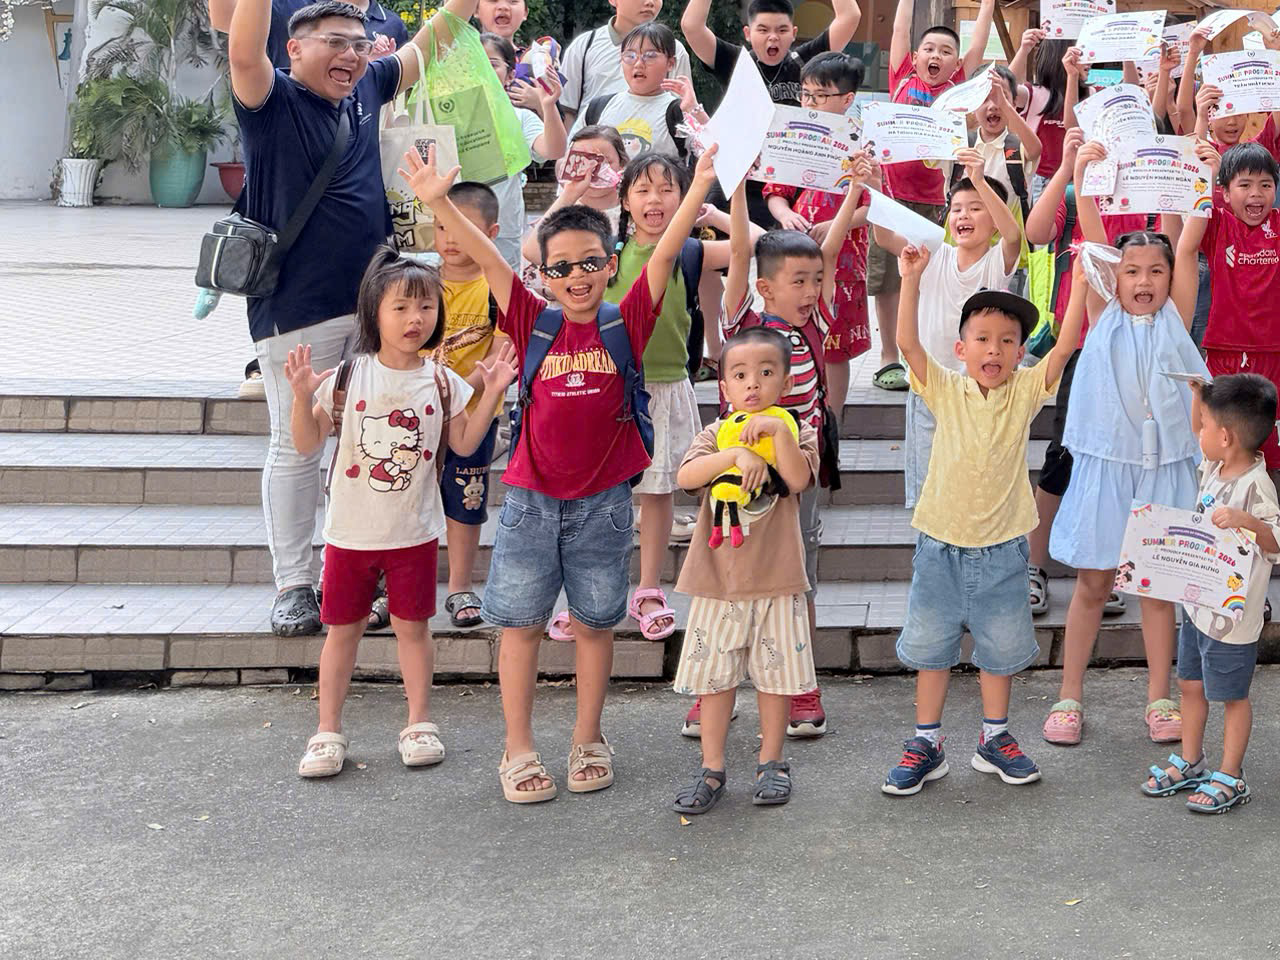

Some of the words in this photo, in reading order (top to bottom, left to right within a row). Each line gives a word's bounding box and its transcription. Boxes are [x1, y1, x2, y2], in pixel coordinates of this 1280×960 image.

[832, 140, 849, 152] 2026
[1147, 159, 1181, 169] PROGRAM
[1183, 163, 1200, 174] 2026
[1142, 537, 1175, 547] SUMMER
[1178, 539, 1217, 557] PROGRAM
[1217, 551, 1237, 567] 2026
[1160, 555, 1188, 566] NGUYỄN
